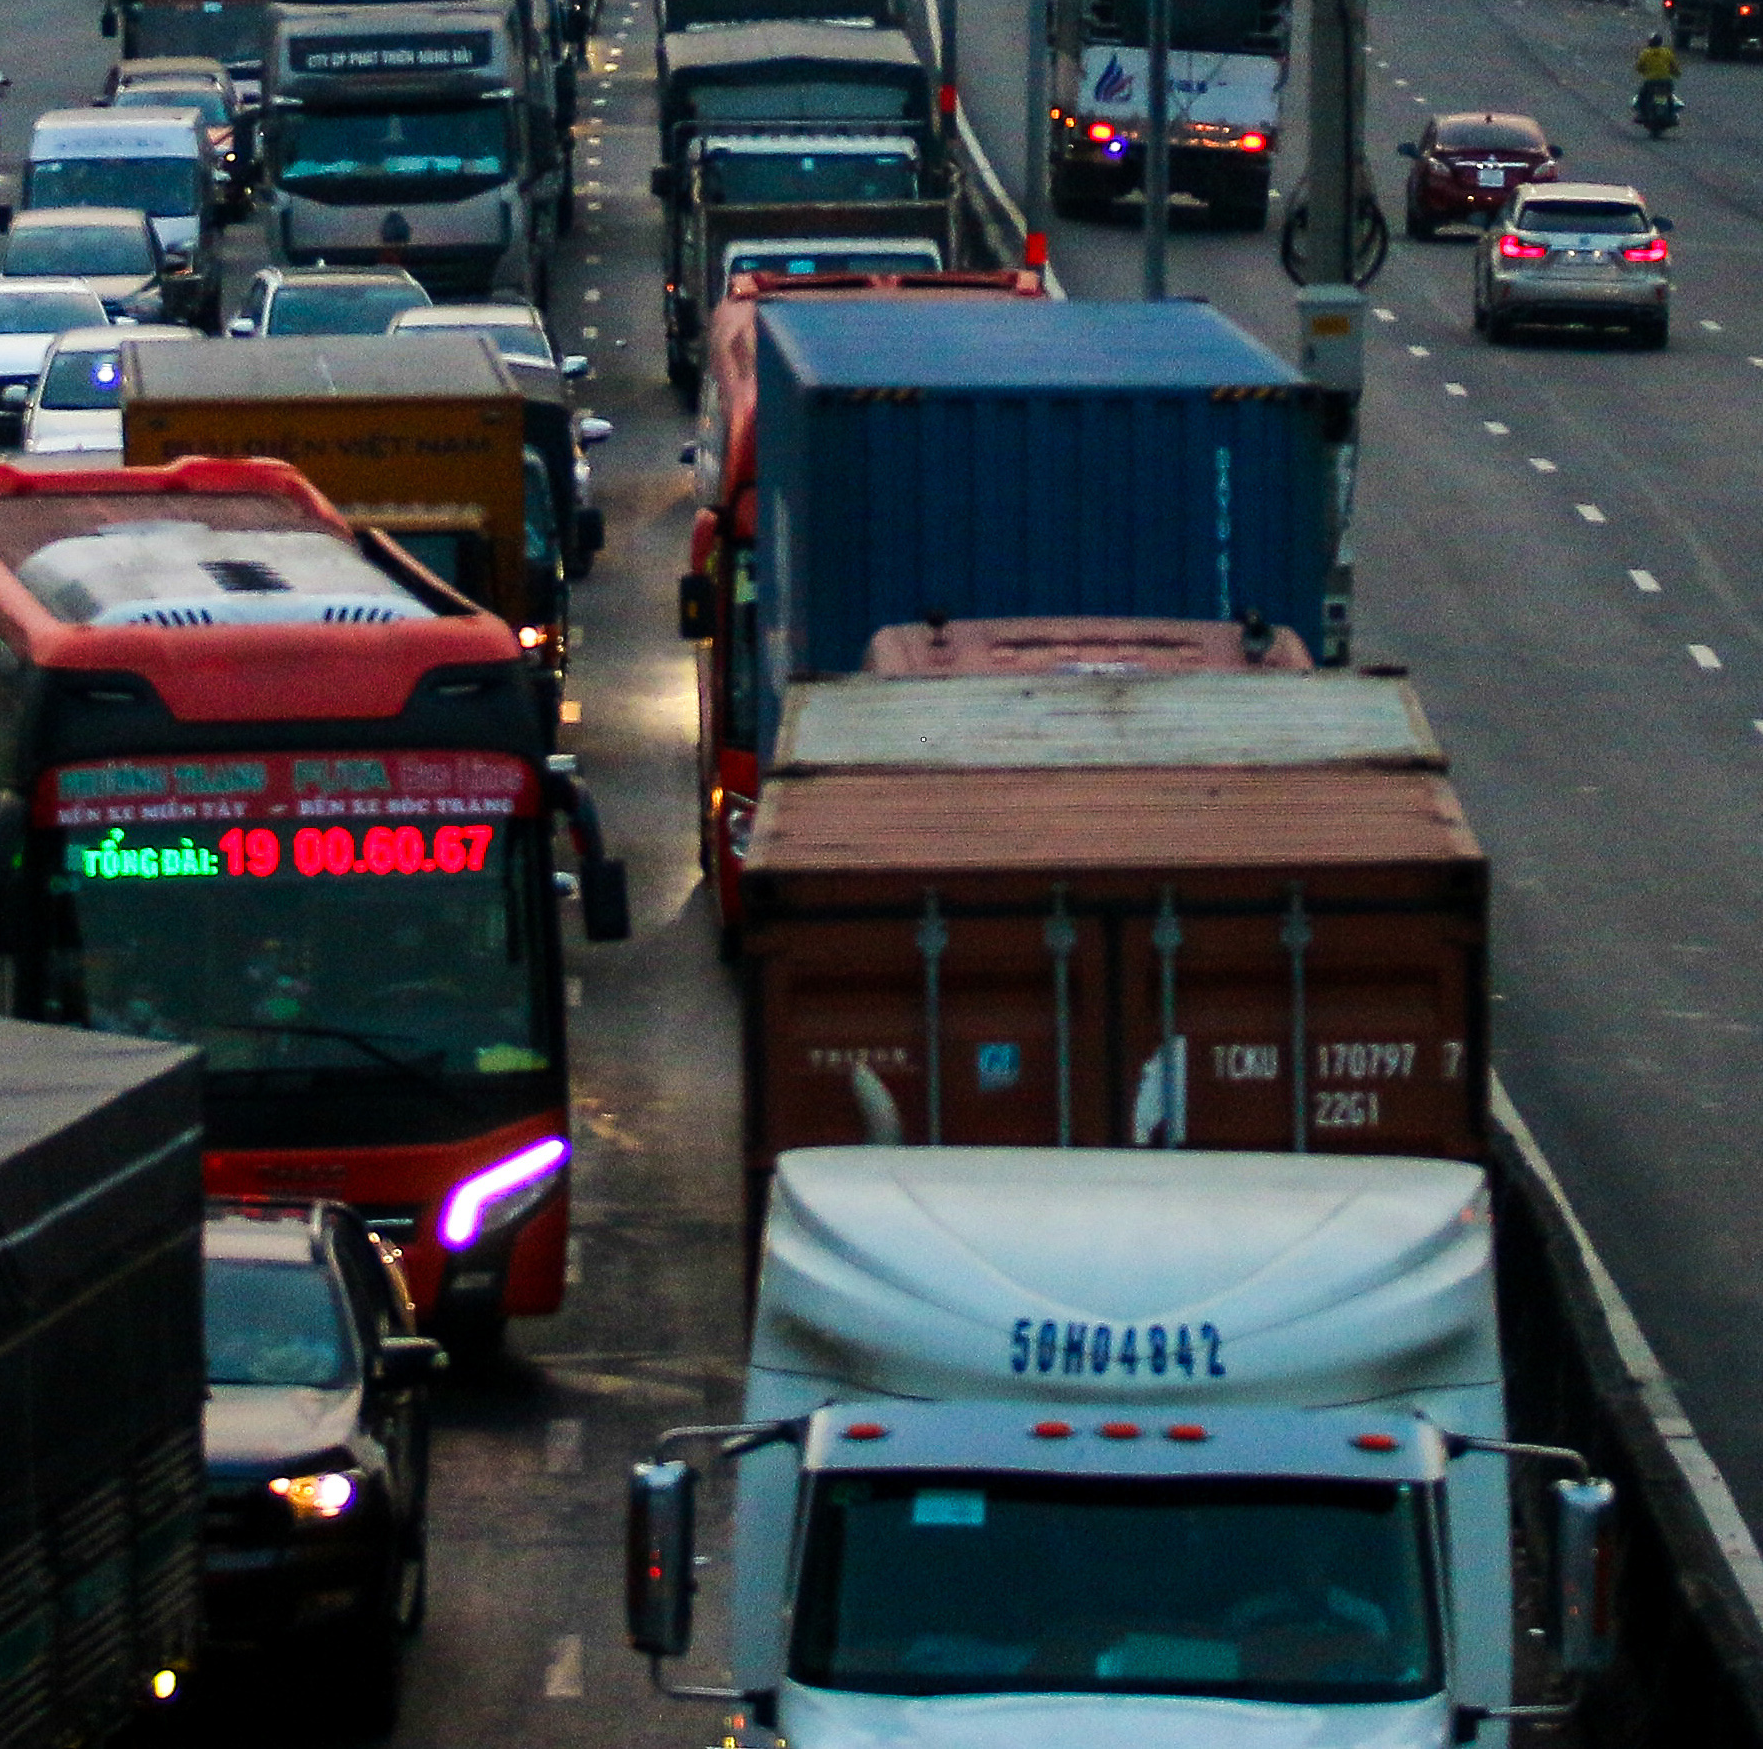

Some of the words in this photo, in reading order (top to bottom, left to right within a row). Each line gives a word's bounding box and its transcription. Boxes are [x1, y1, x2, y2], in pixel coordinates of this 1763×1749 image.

[219, 827, 281, 878] 19
[1317, 1042, 1417, 1079] 170797
[1442, 1041, 1464, 1079] 7
[1010, 1316, 1227, 1378] 50H04842
